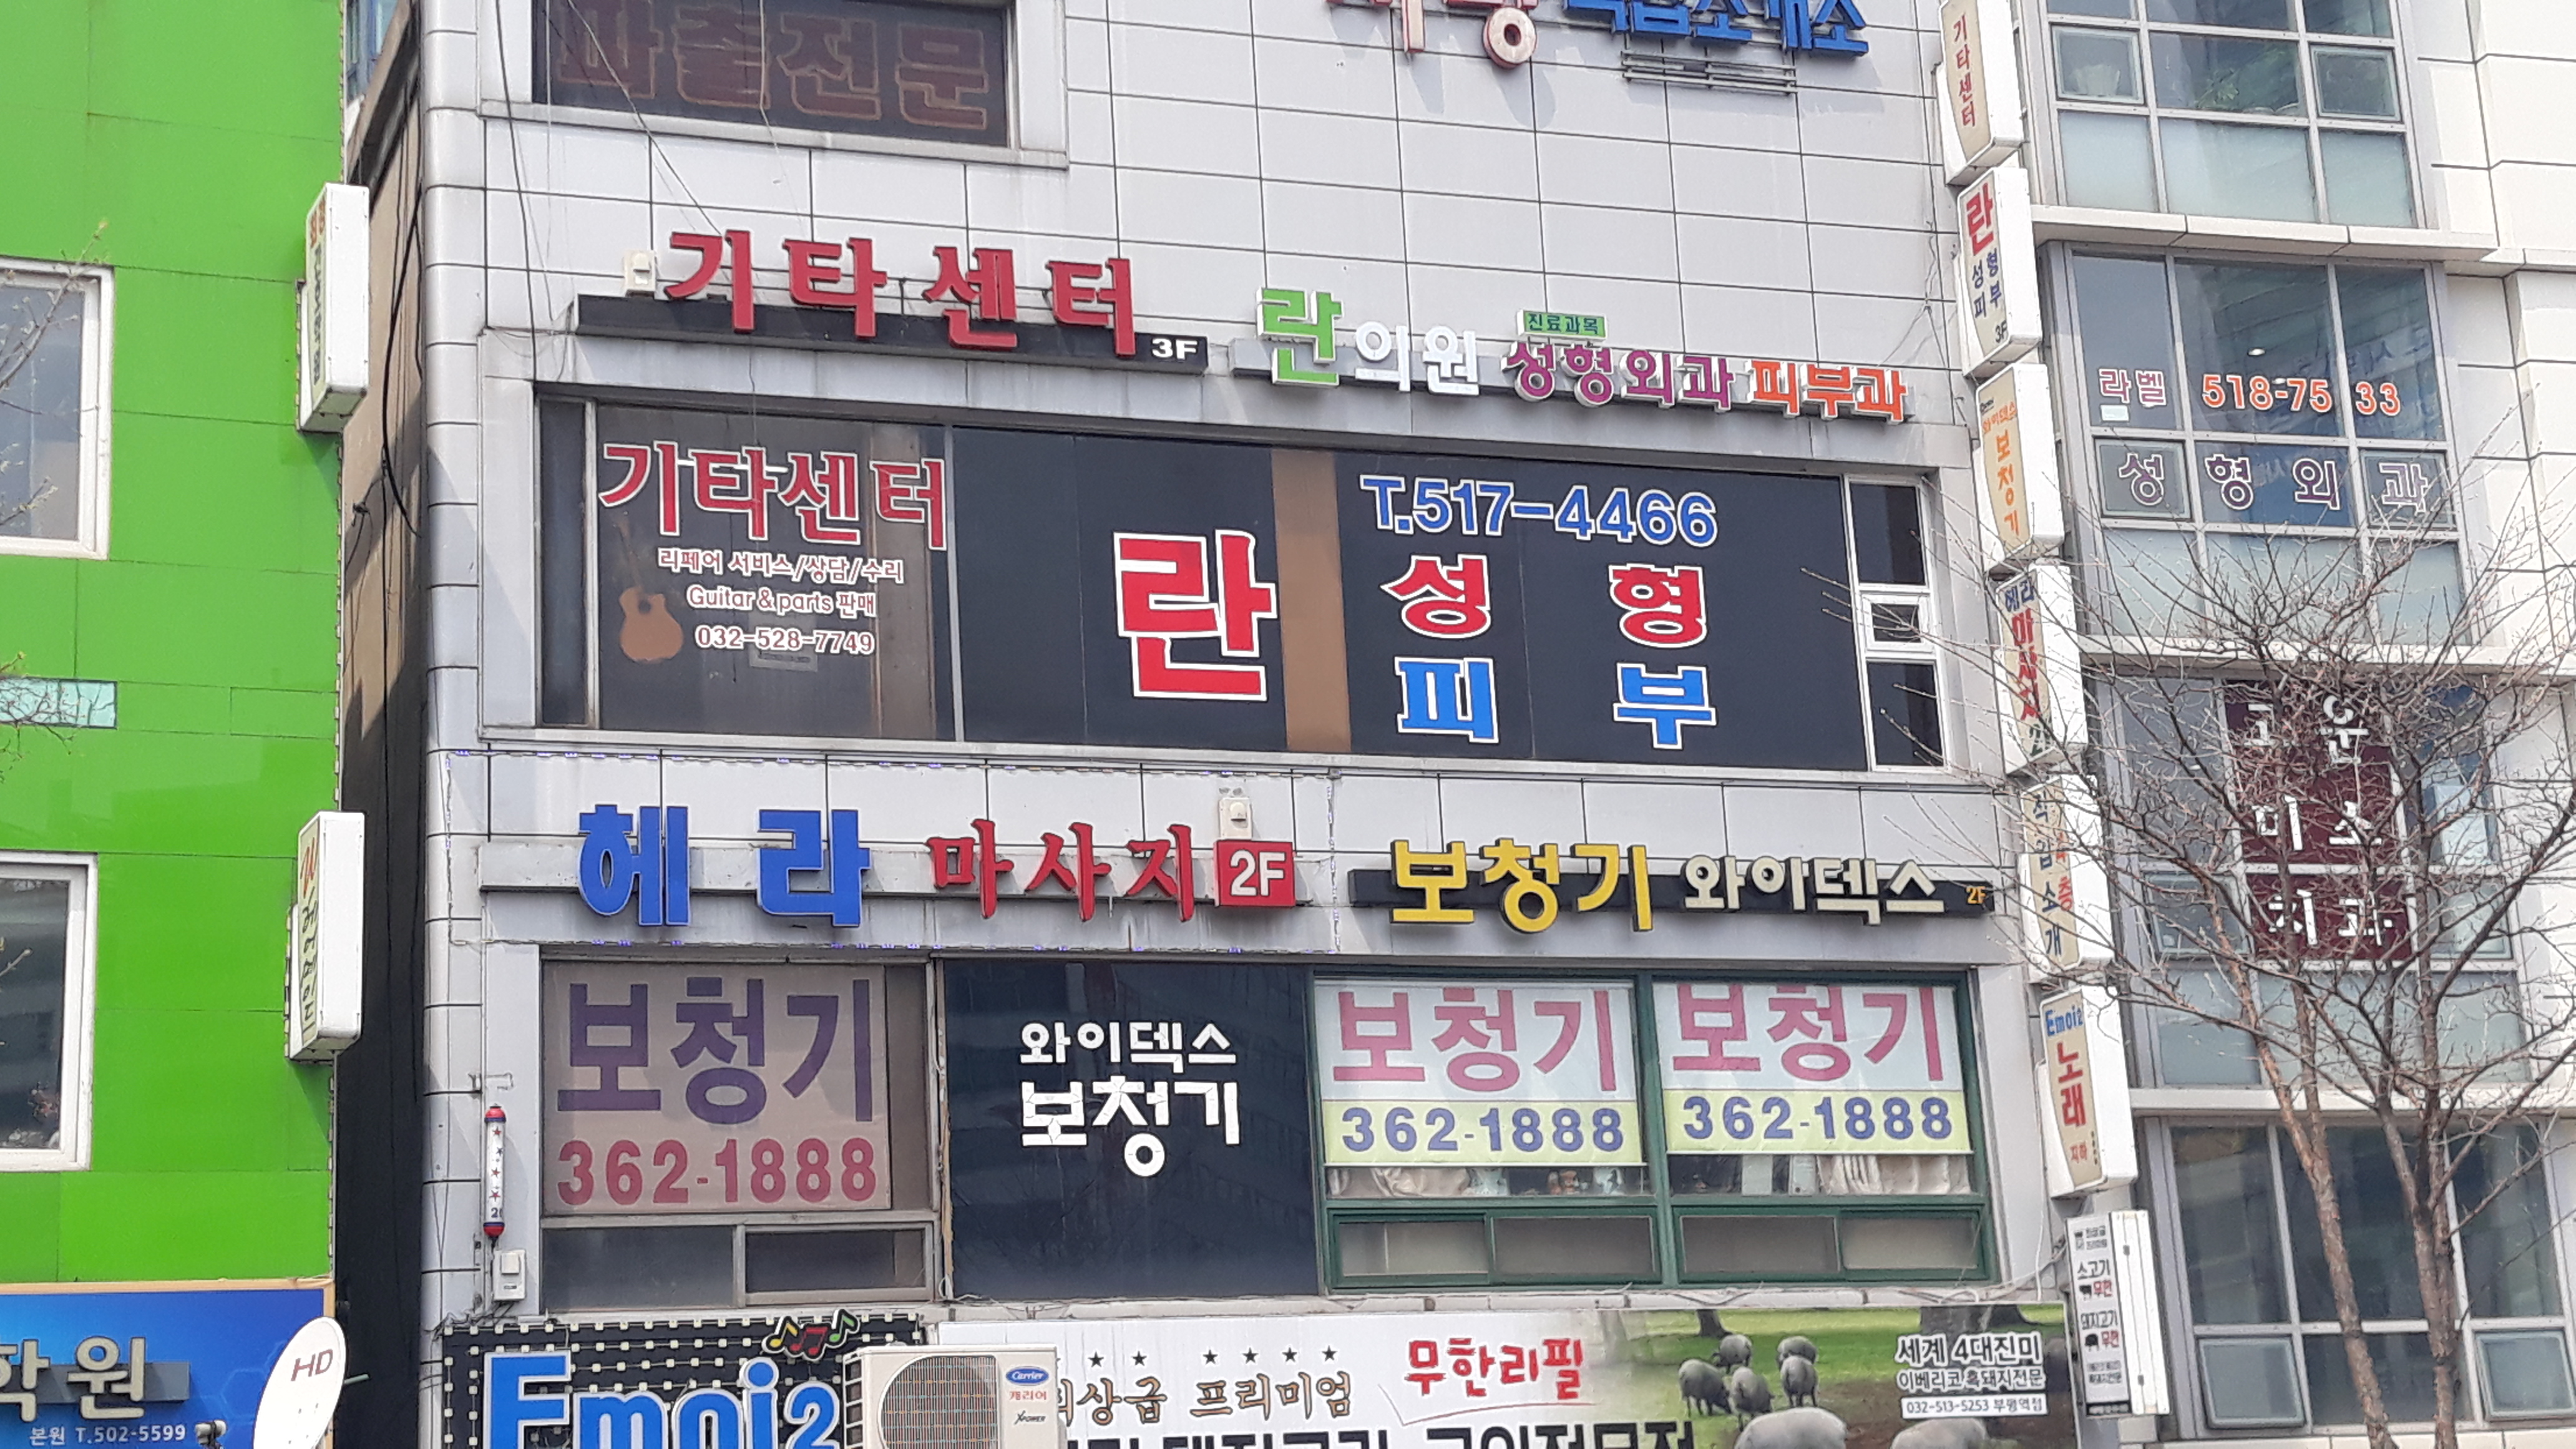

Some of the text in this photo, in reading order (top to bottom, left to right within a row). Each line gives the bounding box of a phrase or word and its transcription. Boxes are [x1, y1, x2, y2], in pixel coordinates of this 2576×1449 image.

[1953, 15, 1976, 127] 기타센터
[1966, 182, 1994, 256] 란
[663, 229, 1199, 359] 기타센터 3F
[1528, 313, 1598, 335] 진료과목
[1994, 320, 2008, 344] 3F
[1501, 341, 1907, 422] 성형외과 피부과
[2099, 368, 2167, 406] 라벨
[598, 440, 949, 552] 기타센터
[1359, 473, 1719, 548] T.517-4466
[1996, 429, 2019, 537] 보청기
[658, 547, 905, 584] 리페어 서비스/상담/수리
[687, 584, 755, 610] Guitar
[776, 592, 833, 615] parts
[836, 591, 877, 618] 판매
[1114, 530, 1278, 702] 란
[695, 625, 875, 655] 032-528-7749
[578, 804, 1287, 927] 헤라 마사지 2F
[1389, 838, 1987, 934] 보청기 와이덱스 2F
[557, 977, 873, 1125] 보청기
[1019, 1021, 1237, 1074] 와이덱스
[1332, 987, 1617, 1092] 보청기
[1672, 985, 1943, 1082] 보청기
[2057, 1042, 2086, 1127] 노래
[1020, 1075, 1240, 1178] 보청기
[1342, 1107, 1624, 1153] 362-1888
[1682, 1096, 1953, 1141] 362-1888
[557, 1137, 876, 1206] 362-1888
[2077, 1259, 2110, 1280] 소고기
[0, 1335, 146, 1422] 학원
[291, 1349, 333, 1382] HD
[1012, 1371, 1044, 1380] Carrier
[1405, 1338, 1583, 1400] 무한리필
[1895, 1332, 2043, 1367] 세계 4대진미
[1009, 1390, 1046, 1400] 캐리어
[1190, 1371, 1351, 1420] 프리미엄
[1907, 1400, 1989, 1413] 032-513-5253
[30, 1425, 186, 1446] 본원 T.502-5599
